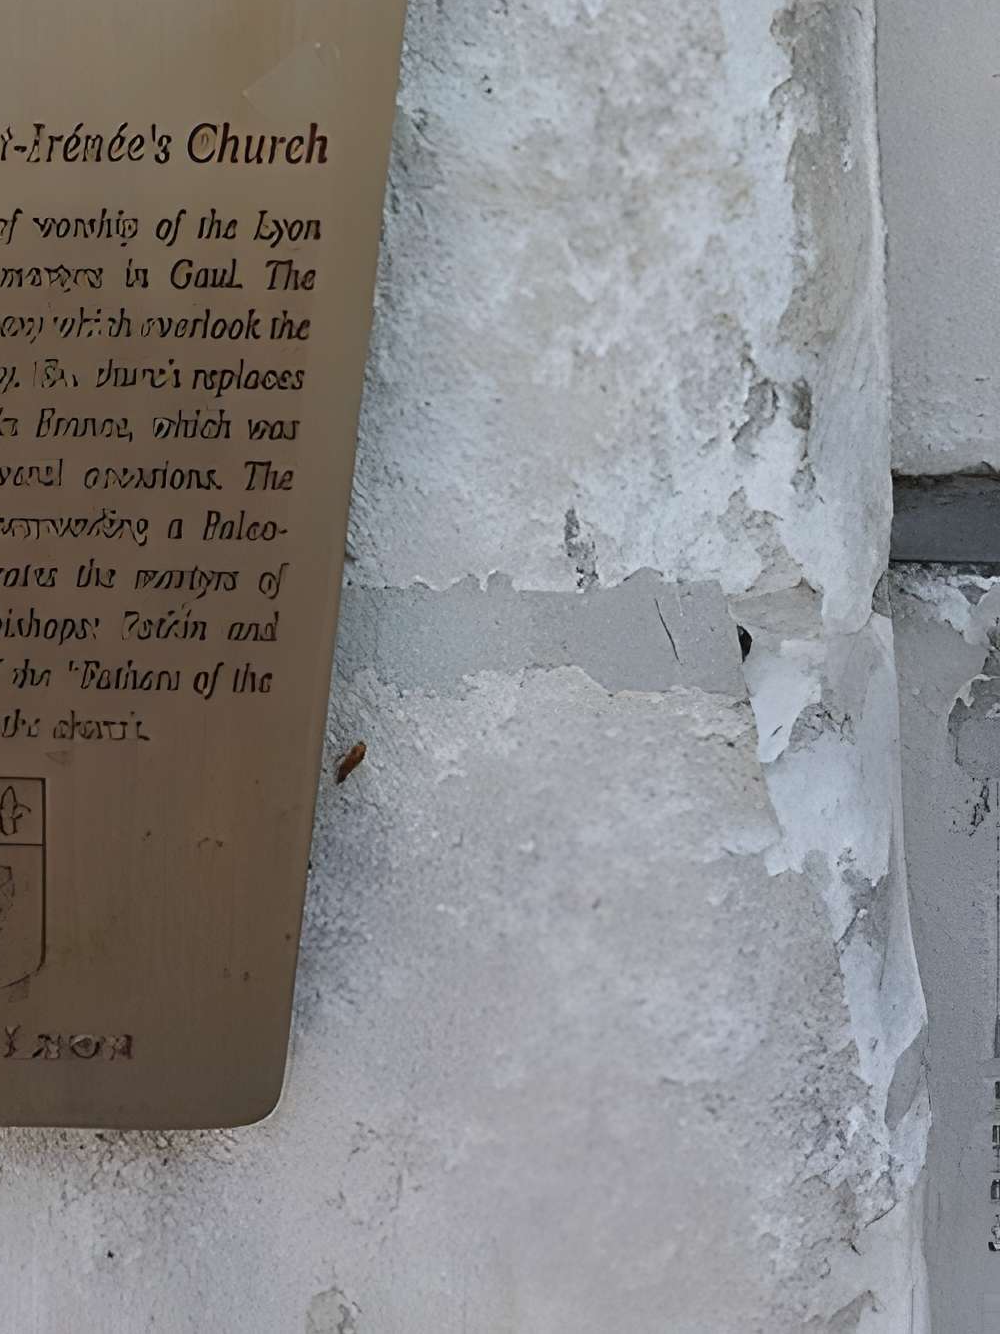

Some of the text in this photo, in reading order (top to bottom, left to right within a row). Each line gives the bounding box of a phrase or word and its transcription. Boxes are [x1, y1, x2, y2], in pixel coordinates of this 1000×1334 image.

[186, 120, 328, 165] Church
[154, 207, 187, 248] of
[196, 206, 239, 240] the
[251, 208, 322, 249] Lyon
[124, 256, 149, 289] in
[263, 257, 317, 291] The
[268, 308, 311, 341] the
[190, 357, 306, 398] replaces
[151, 407, 232, 440] which
[246, 417, 301, 441] was
[242, 459, 294, 492] The
[166, 517, 184, 540] a
[201, 508, 289, 542] Paleo-
[75, 556, 117, 589] the
[257, 561, 290, 601] of
[225, 609, 280, 642] and
[191, 660, 225, 701] of
[231, 661, 273, 694] the
